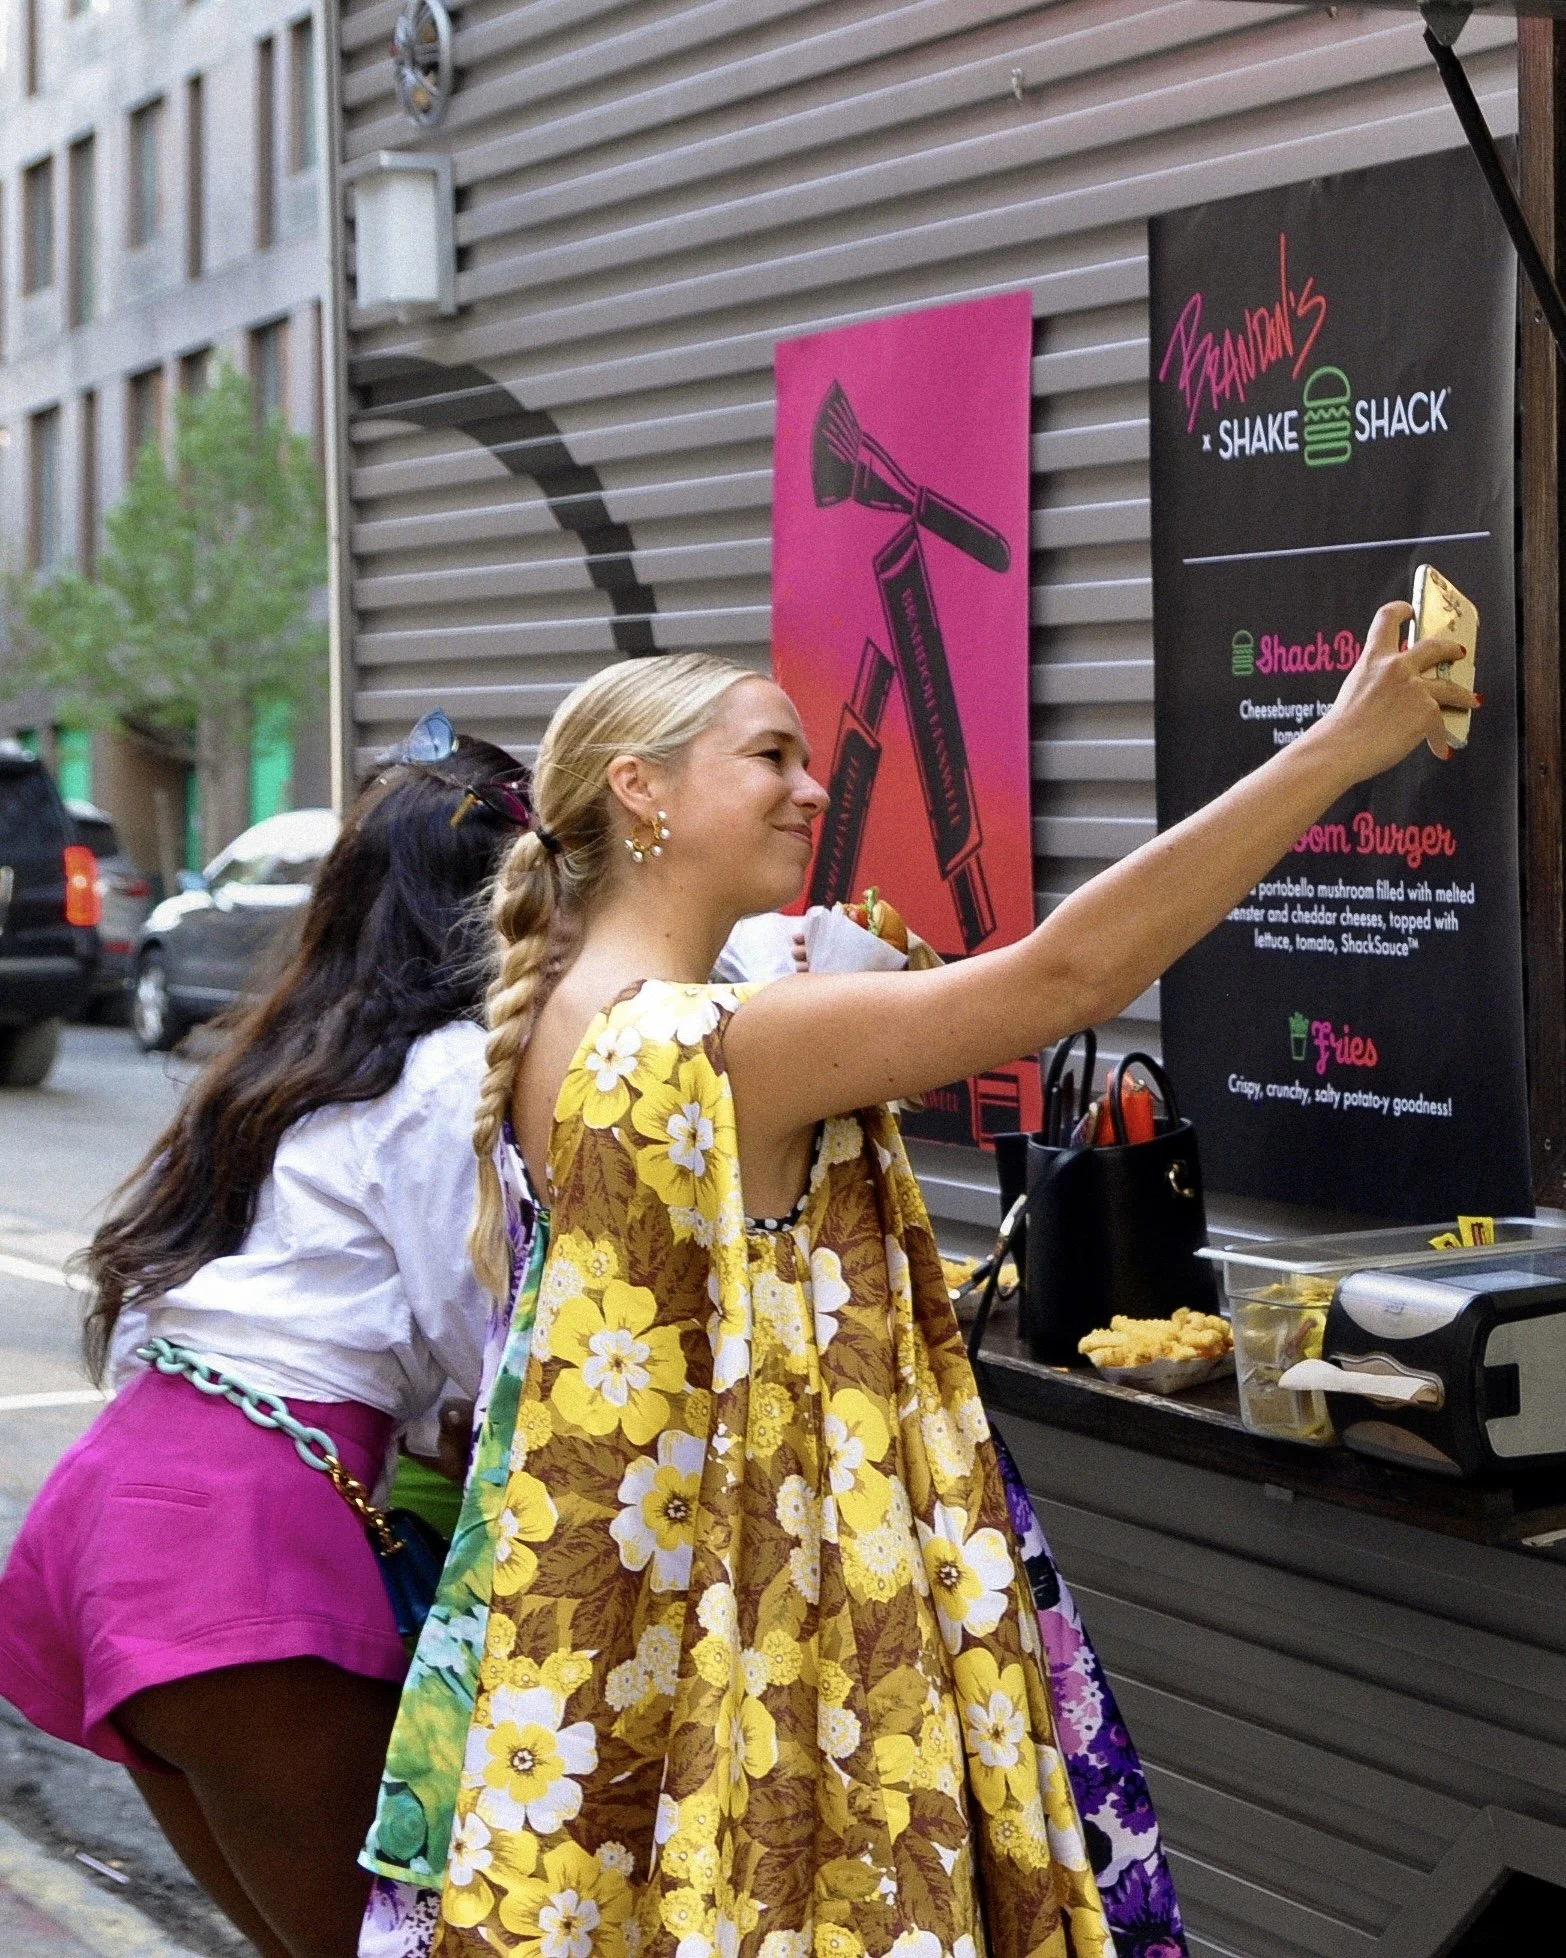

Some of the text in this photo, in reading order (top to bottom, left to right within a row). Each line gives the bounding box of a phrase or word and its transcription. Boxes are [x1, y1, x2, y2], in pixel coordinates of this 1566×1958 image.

[1219, 410, 1299, 460] SHAKE
[1240, 697, 1315, 724] Cheeseburger
[1353, 811, 1456, 870] Burger
[1258, 876, 1475, 904] portobello mushroom filled with melted
[1267, 902, 1289, 923] and
[1291, 903, 1337, 925] cheddar
[1340, 904, 1387, 931] cheeses,
[1389, 908, 1432, 935] topped
[1434, 909, 1459, 931] with
[1254, 927, 1293, 953] lettuce,
[1296, 933, 1338, 955] tomato,
[1311, 1019, 1380, 1075] Fries
[1228, 1073, 1453, 1117] Crispy, crunchy, salty potato-y goodness!
